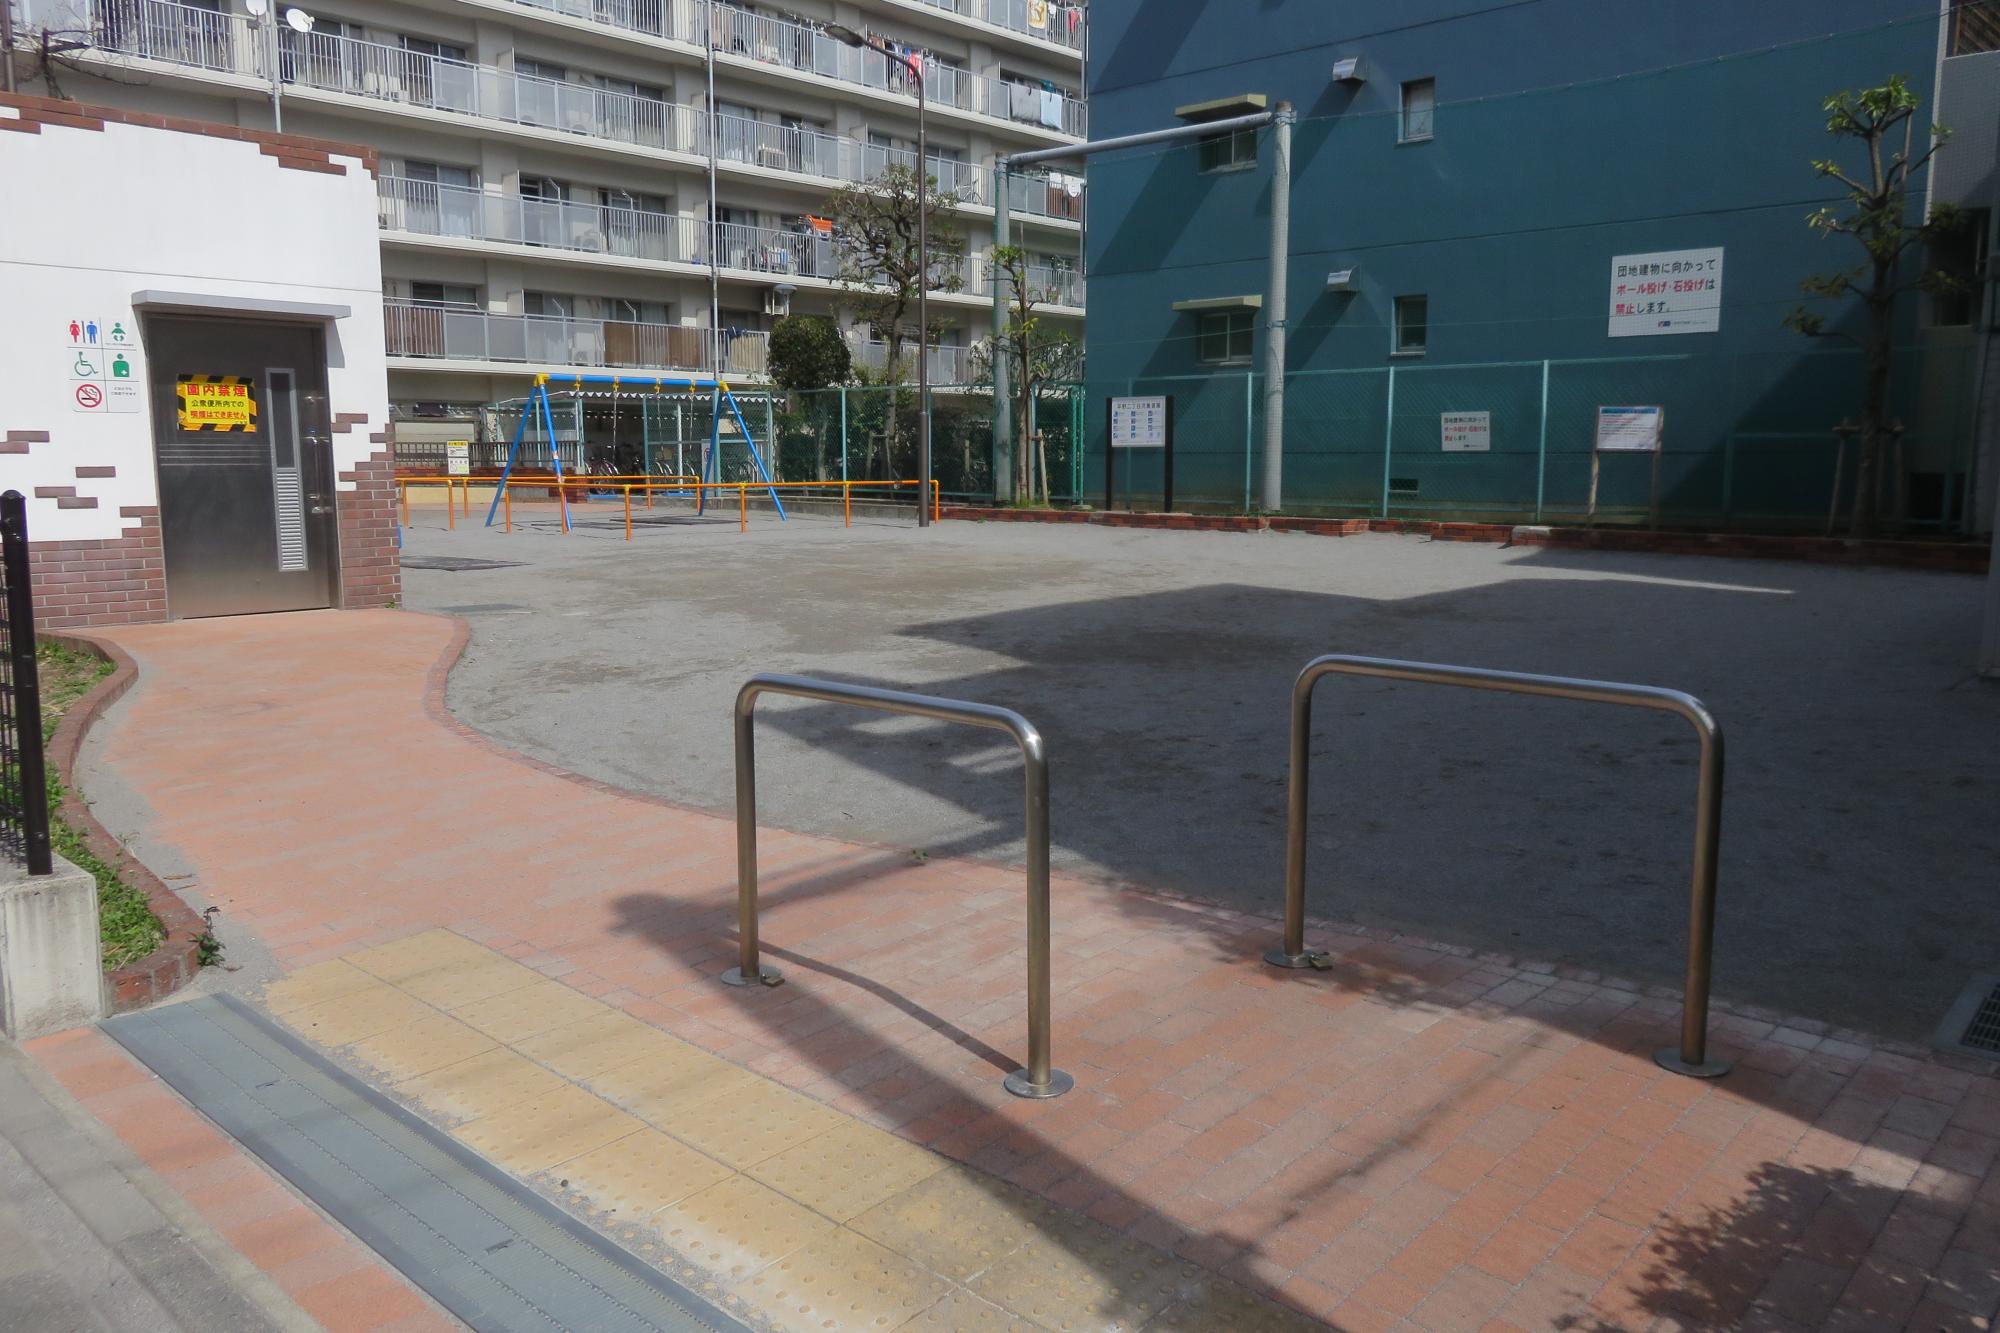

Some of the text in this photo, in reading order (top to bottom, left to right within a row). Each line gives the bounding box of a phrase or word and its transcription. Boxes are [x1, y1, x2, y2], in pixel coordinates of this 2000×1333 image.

[1617, 259, 1716, 278] 団地建物に向かって
[1616, 279, 1715, 296] ボール投げ・石投げは
[1615, 301, 1670, 315] 禁止します。
[187, 383, 247, 397] 園内禁煙
[192, 400, 244, 408] 公衆便所内での
[190, 410, 246, 419] 喫煙はできません
